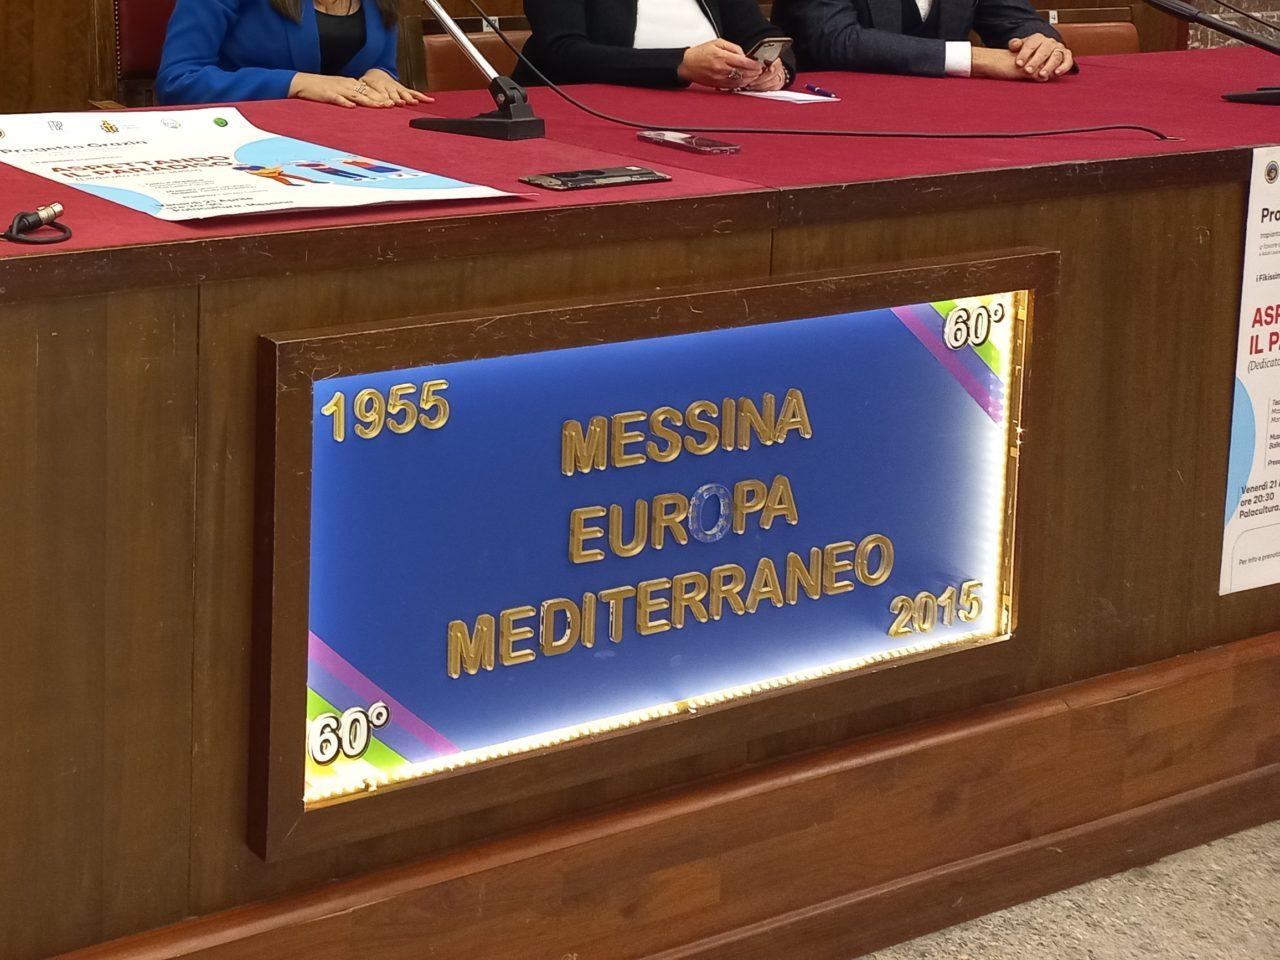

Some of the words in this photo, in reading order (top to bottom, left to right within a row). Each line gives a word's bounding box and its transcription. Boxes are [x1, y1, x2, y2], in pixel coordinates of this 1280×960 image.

[51, 155, 230, 174] ASPETTANDO
[92, 161, 234, 176] PARADISO
[943, 301, 1005, 351] 60°
[1249, 334, 1264, 355] IL
[1268, 331, 1280, 352] P
[320, 378, 451, 443] 1955
[560, 387, 813, 477] MESSINA
[1240, 497, 1252, 507] ore
[1253, 491, 1275, 504] 20:30
[1269, 479, 1278, 489] 21
[568, 473, 800, 566] EUROPA
[446, 533, 895, 680] MEDITERRANEO
[887, 580, 985, 639] 2015
[307, 700, 391, 766] 60°
